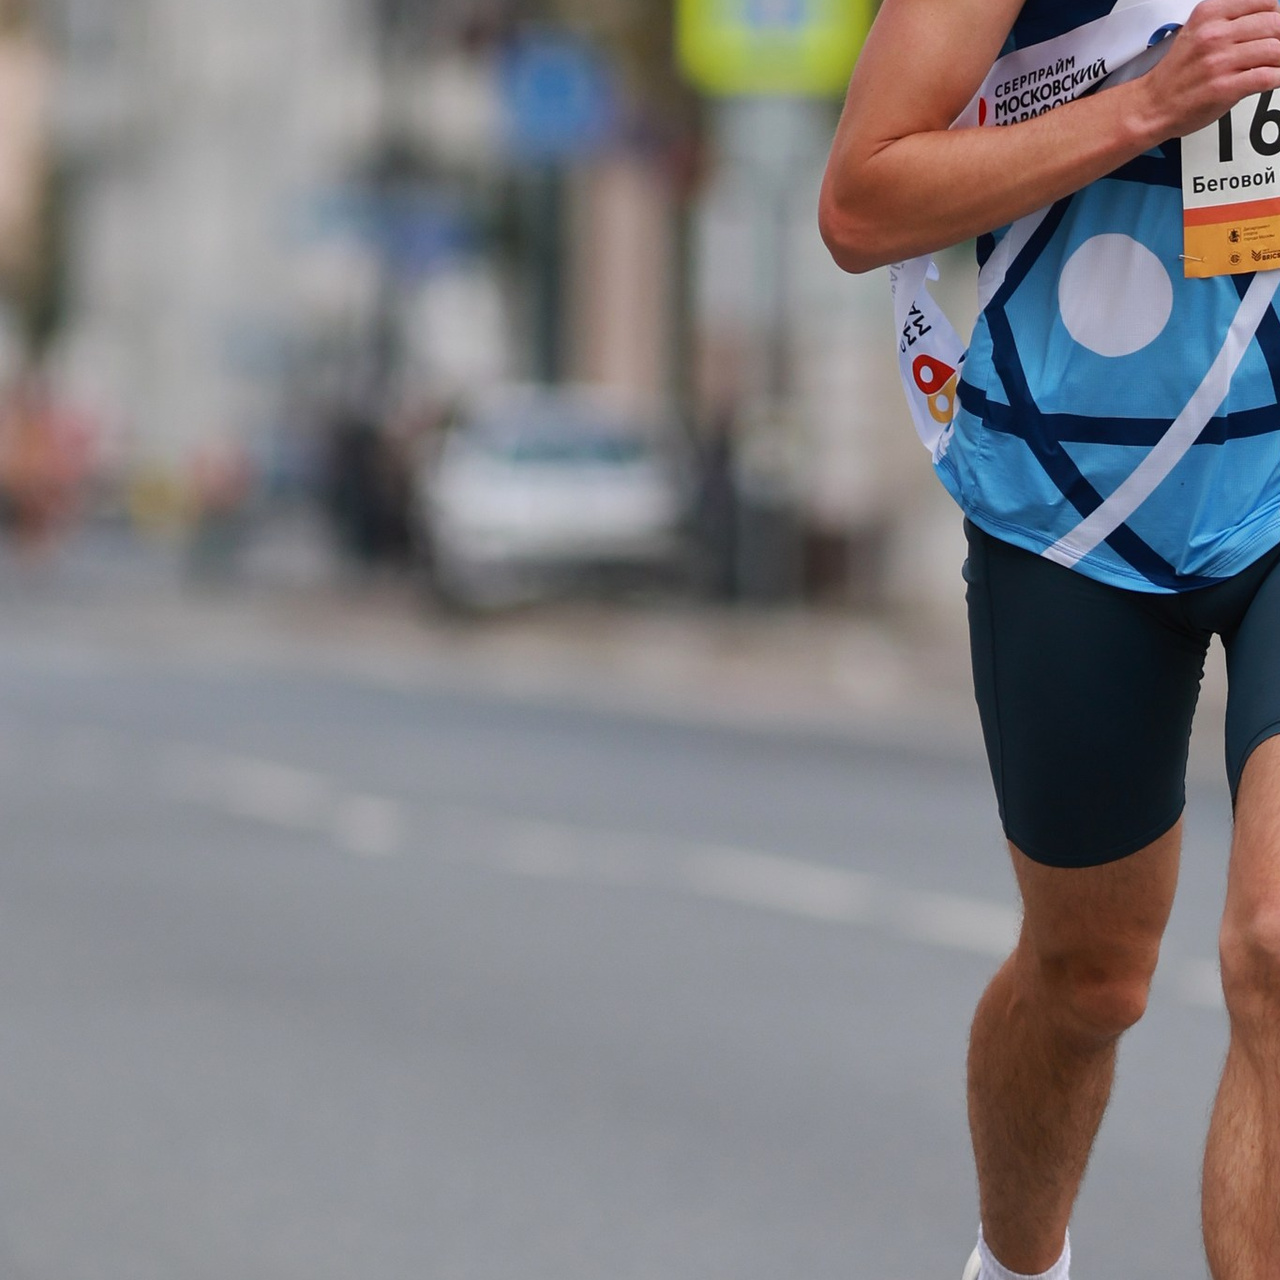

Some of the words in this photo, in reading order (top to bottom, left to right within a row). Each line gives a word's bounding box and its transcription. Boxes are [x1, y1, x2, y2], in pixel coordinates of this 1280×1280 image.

[994, 55, 1076, 98] СБЕРПРАЙМ
[994, 57, 1109, 119] МОСКОВСКИЙ
[1192, 167, 1276, 194] Беговой
